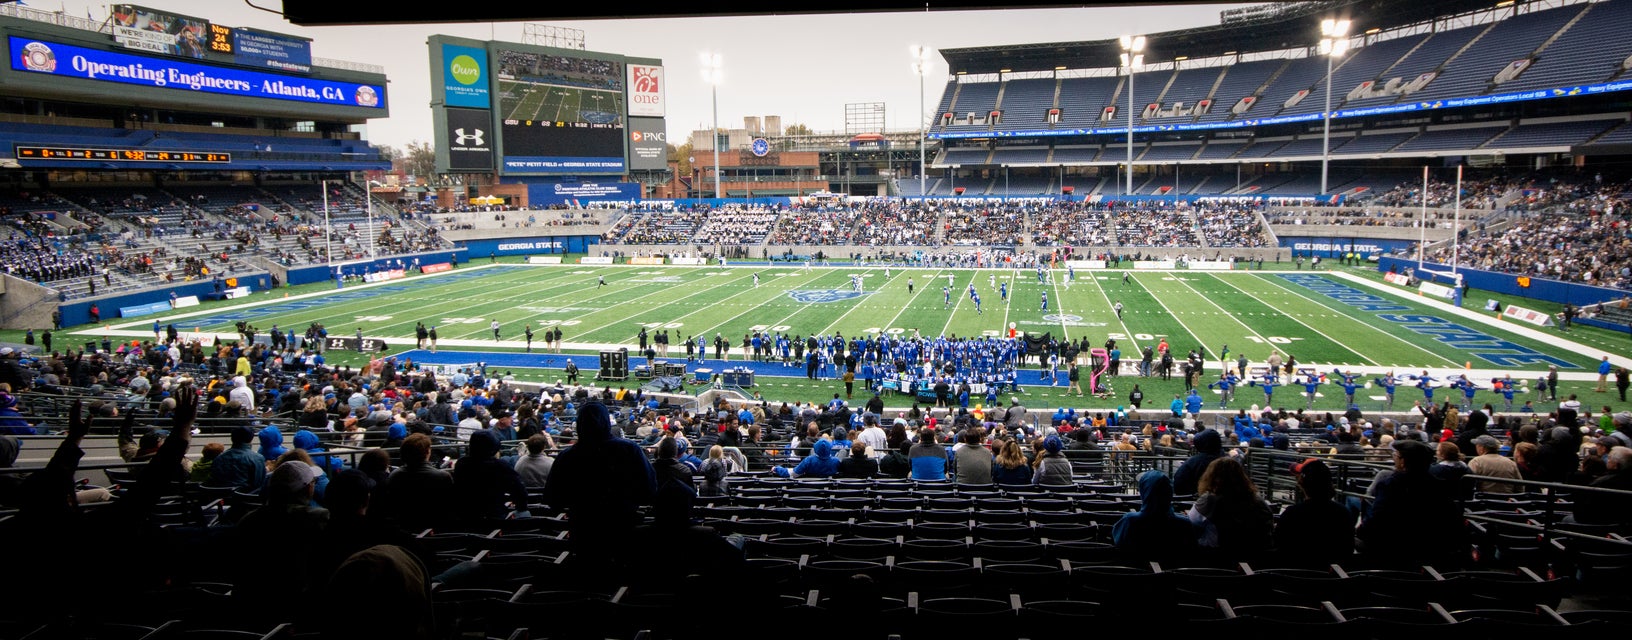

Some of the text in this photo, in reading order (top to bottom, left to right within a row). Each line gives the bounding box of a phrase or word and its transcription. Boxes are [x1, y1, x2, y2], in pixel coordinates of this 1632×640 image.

[120, 28, 143, 37] WE'RE
[211, 24, 230, 35] Nov
[214, 34, 226, 43] 24
[251, 35, 275, 43] LARGEST
[275, 38, 304, 48] UNIVERSITY
[128, 40, 162, 51] BIG DEAL
[211, 41, 231, 52] 3:53
[247, 41, 270, 49] GEORGIA
[262, 49, 289, 58] STUDENTS
[266, 60, 310, 72] #thestateway
[452, 63, 478, 76] Own
[72, 55, 166, 86] Operating
[168, 67, 250, 91] Engineers
[261, 80, 320, 100] Atlanta,
[322, 86, 345, 101] GA
[633, 94, 660, 104] one
[643, 132, 665, 142] PNC
[85, 150, 91, 158] 2
[110, 151, 117, 159] 6
[124, 150, 144, 160] 9:32
[498, 241, 562, 251] GEORGIA STATE
[1294, 242, 1377, 252] GEORGIA STATE
[225, 277, 238, 288] 40
[1516, 275, 1531, 288] 40
[1107, 332, 1155, 340] 20
[1245, 335, 1292, 344] 10
[1375, 313, 1587, 370] STATE
